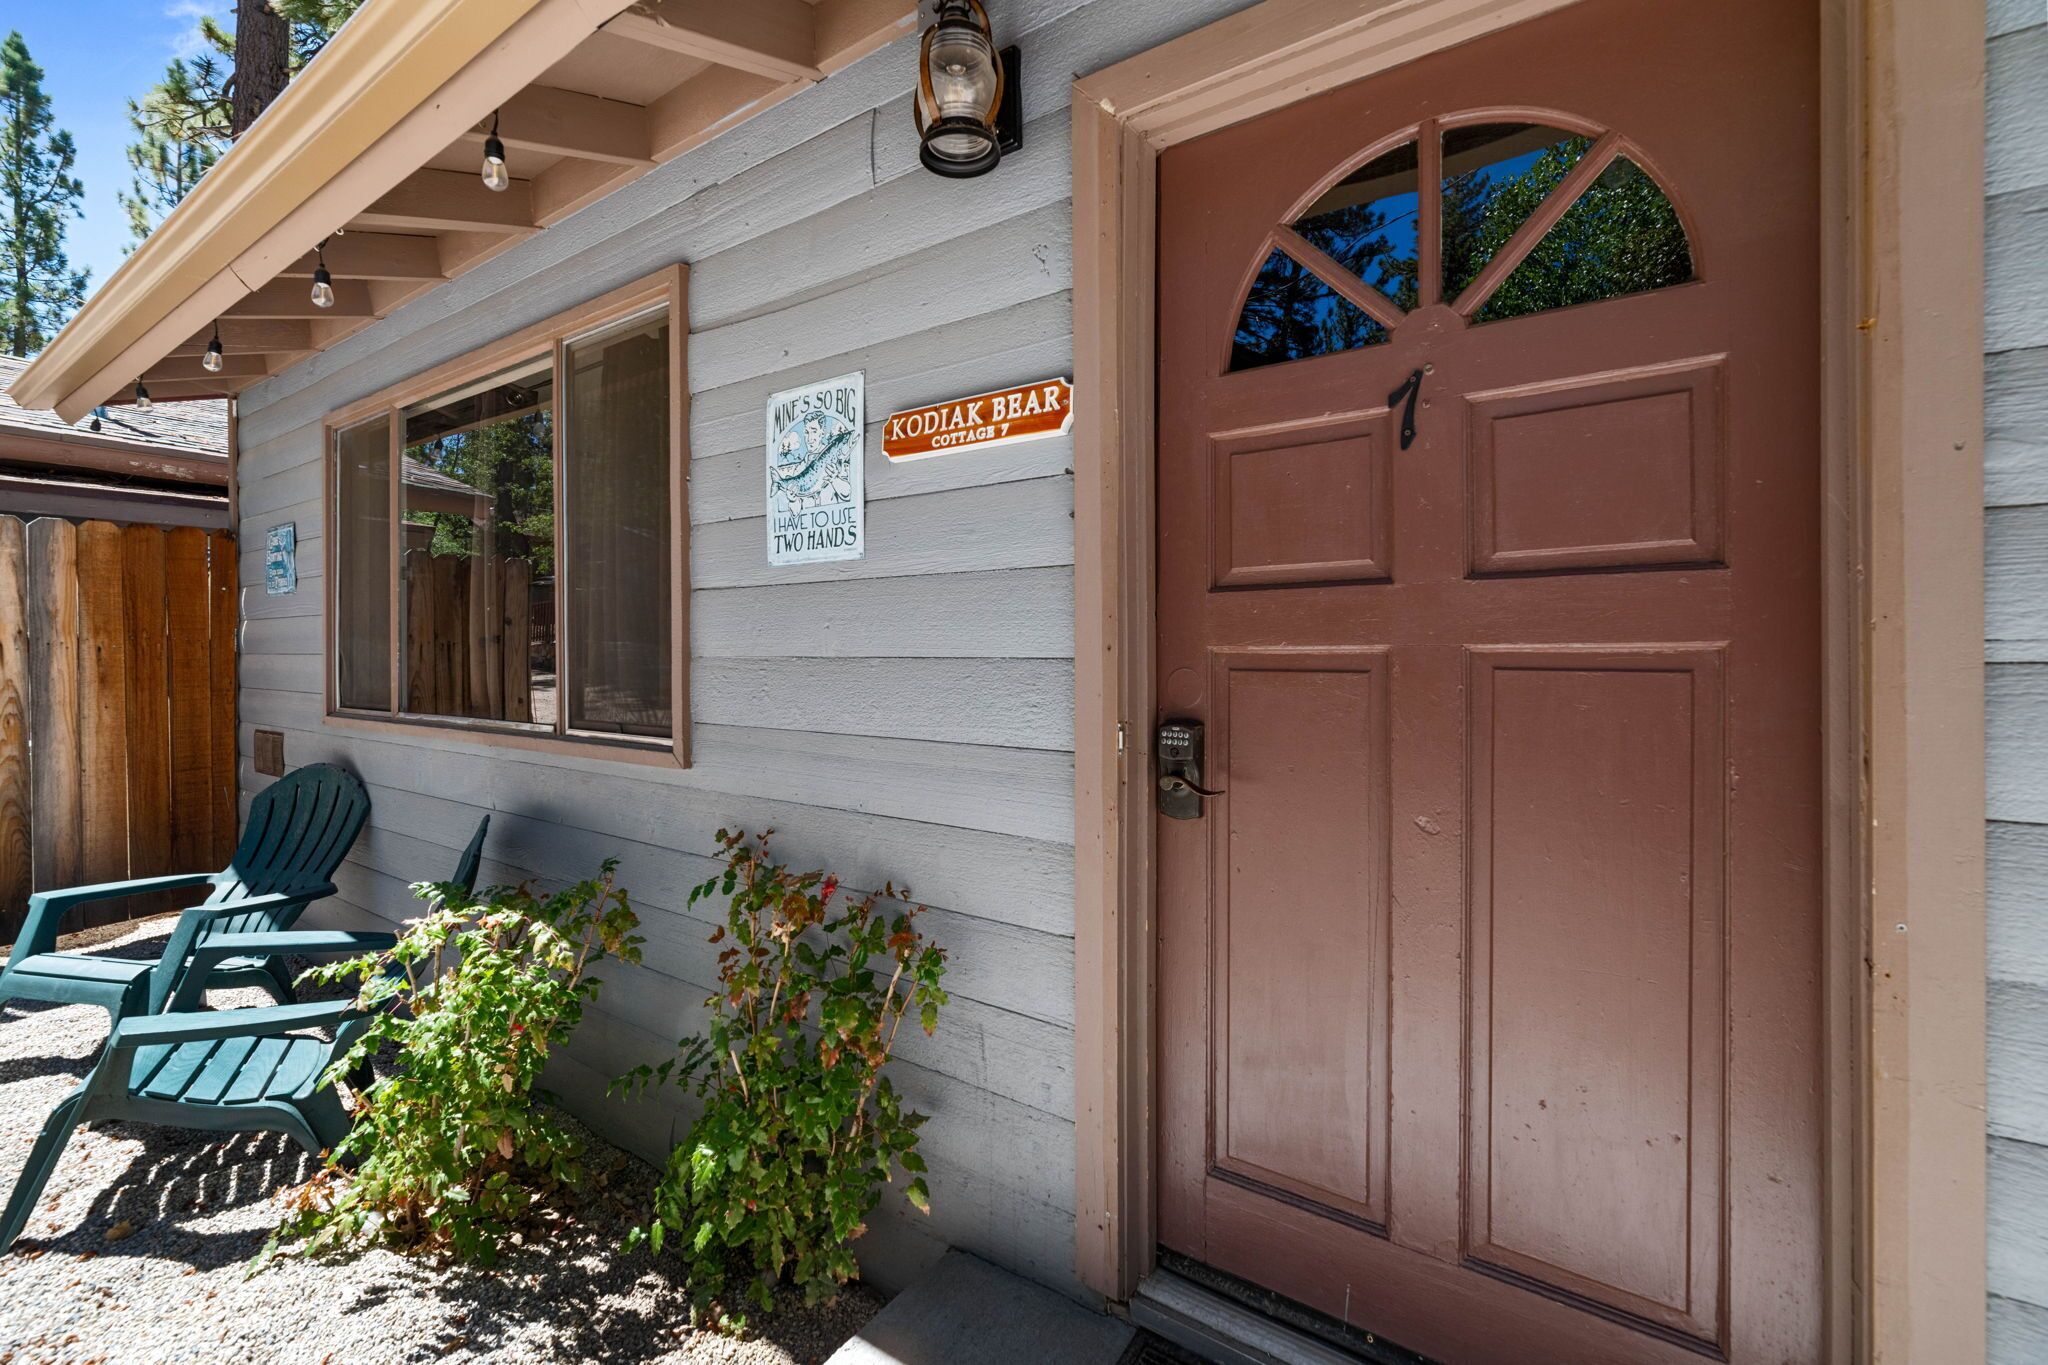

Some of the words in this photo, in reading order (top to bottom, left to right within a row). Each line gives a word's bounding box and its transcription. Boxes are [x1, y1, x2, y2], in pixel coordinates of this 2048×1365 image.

[772, 395, 810, 443] MINE'S
[813, 390, 833, 410] SO
[835, 387, 856, 428] BIG
[890, 400, 984, 441] KODIAK
[992, 385, 1061, 422] BEAR
[931, 425, 995, 448] COTTAGE
[1001, 423, 1010, 437] 7
[778, 513, 808, 533] HAVE
[810, 510, 829, 529] TO
[831, 506, 857, 526] USE
[773, 531, 804, 554] TWO
[806, 525, 857, 551] HANDS
